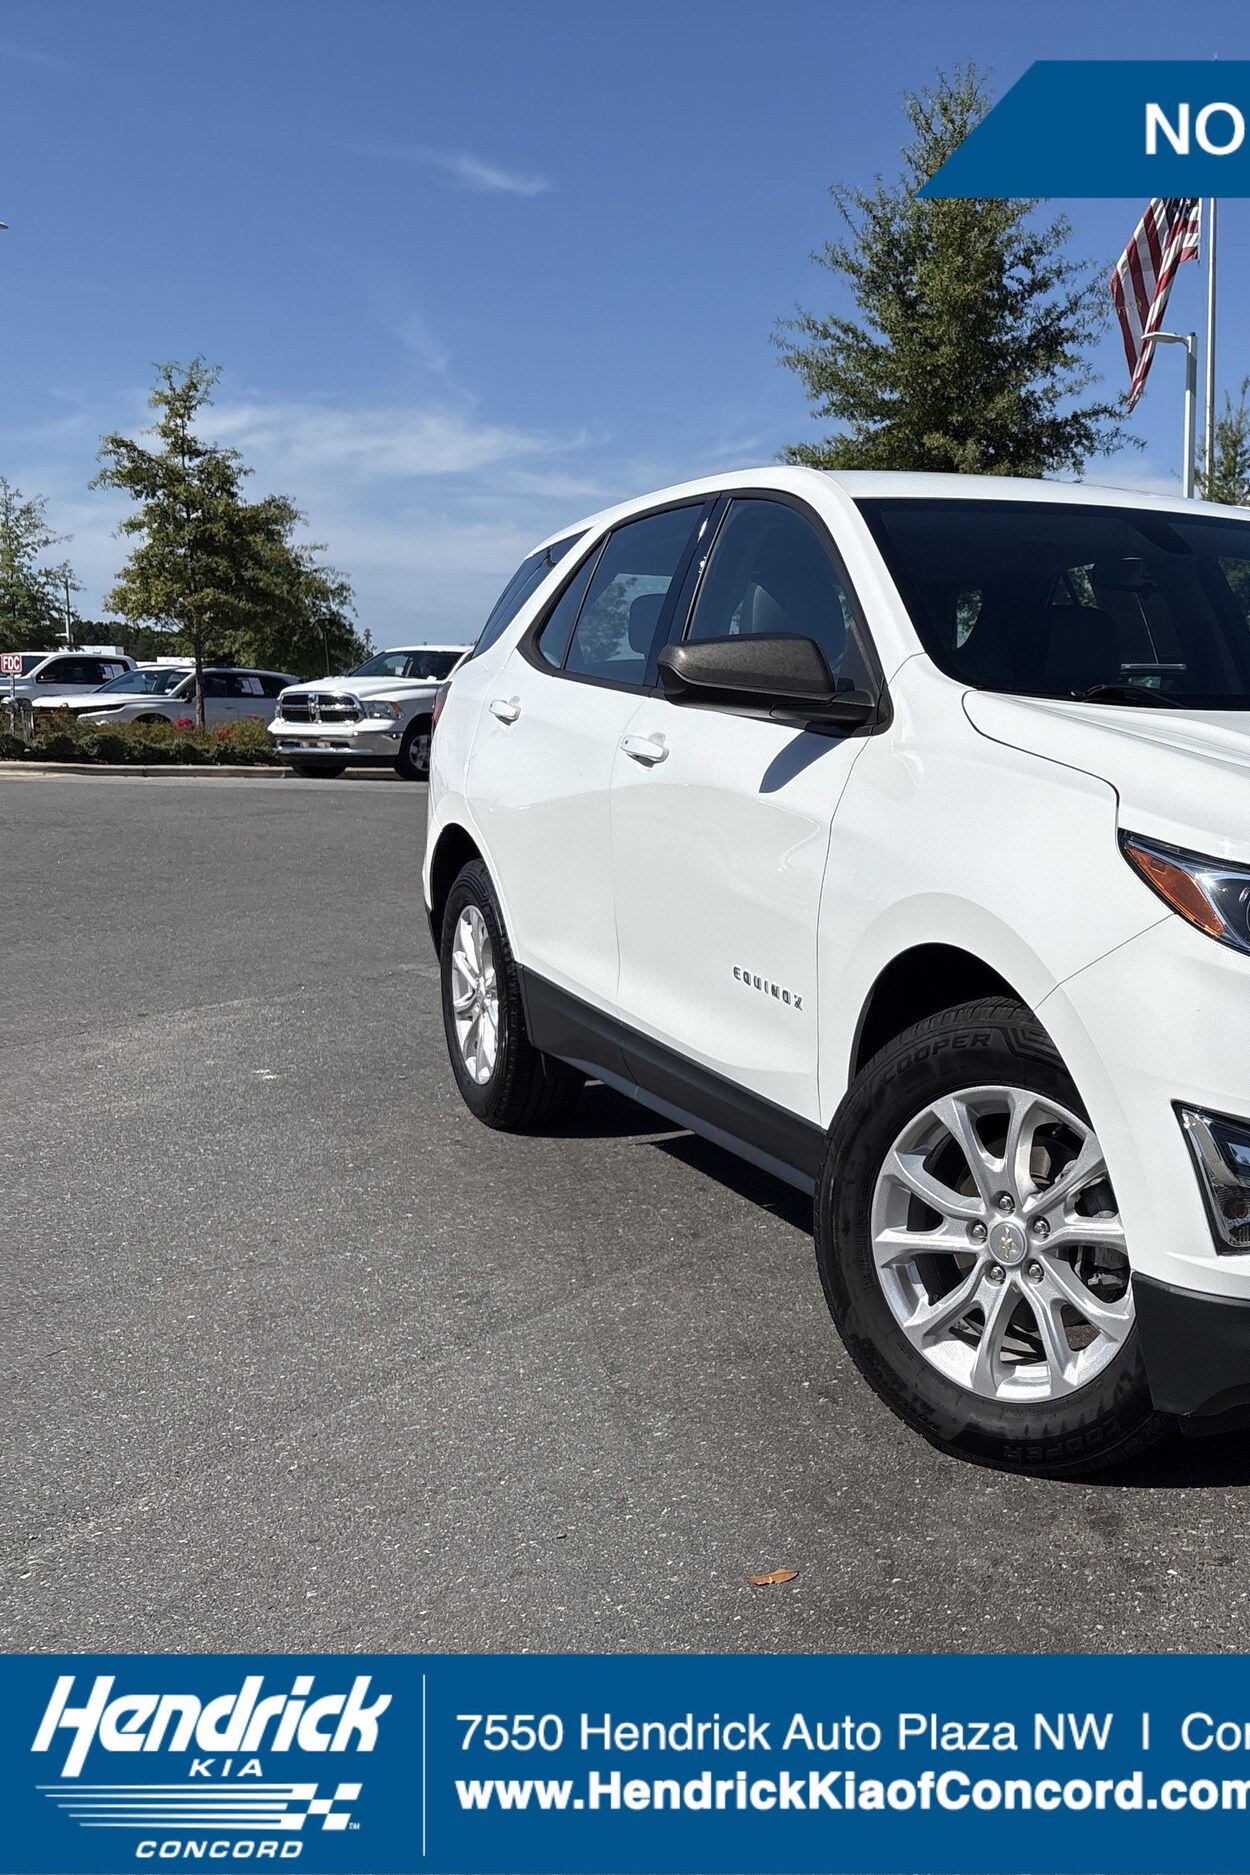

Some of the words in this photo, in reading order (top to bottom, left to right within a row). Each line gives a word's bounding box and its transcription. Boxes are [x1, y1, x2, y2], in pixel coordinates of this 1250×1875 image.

[3, 656, 20, 670] FDC
[733, 966, 803, 1011] EQUINOX
[882, 1033, 991, 1086] COOPER
